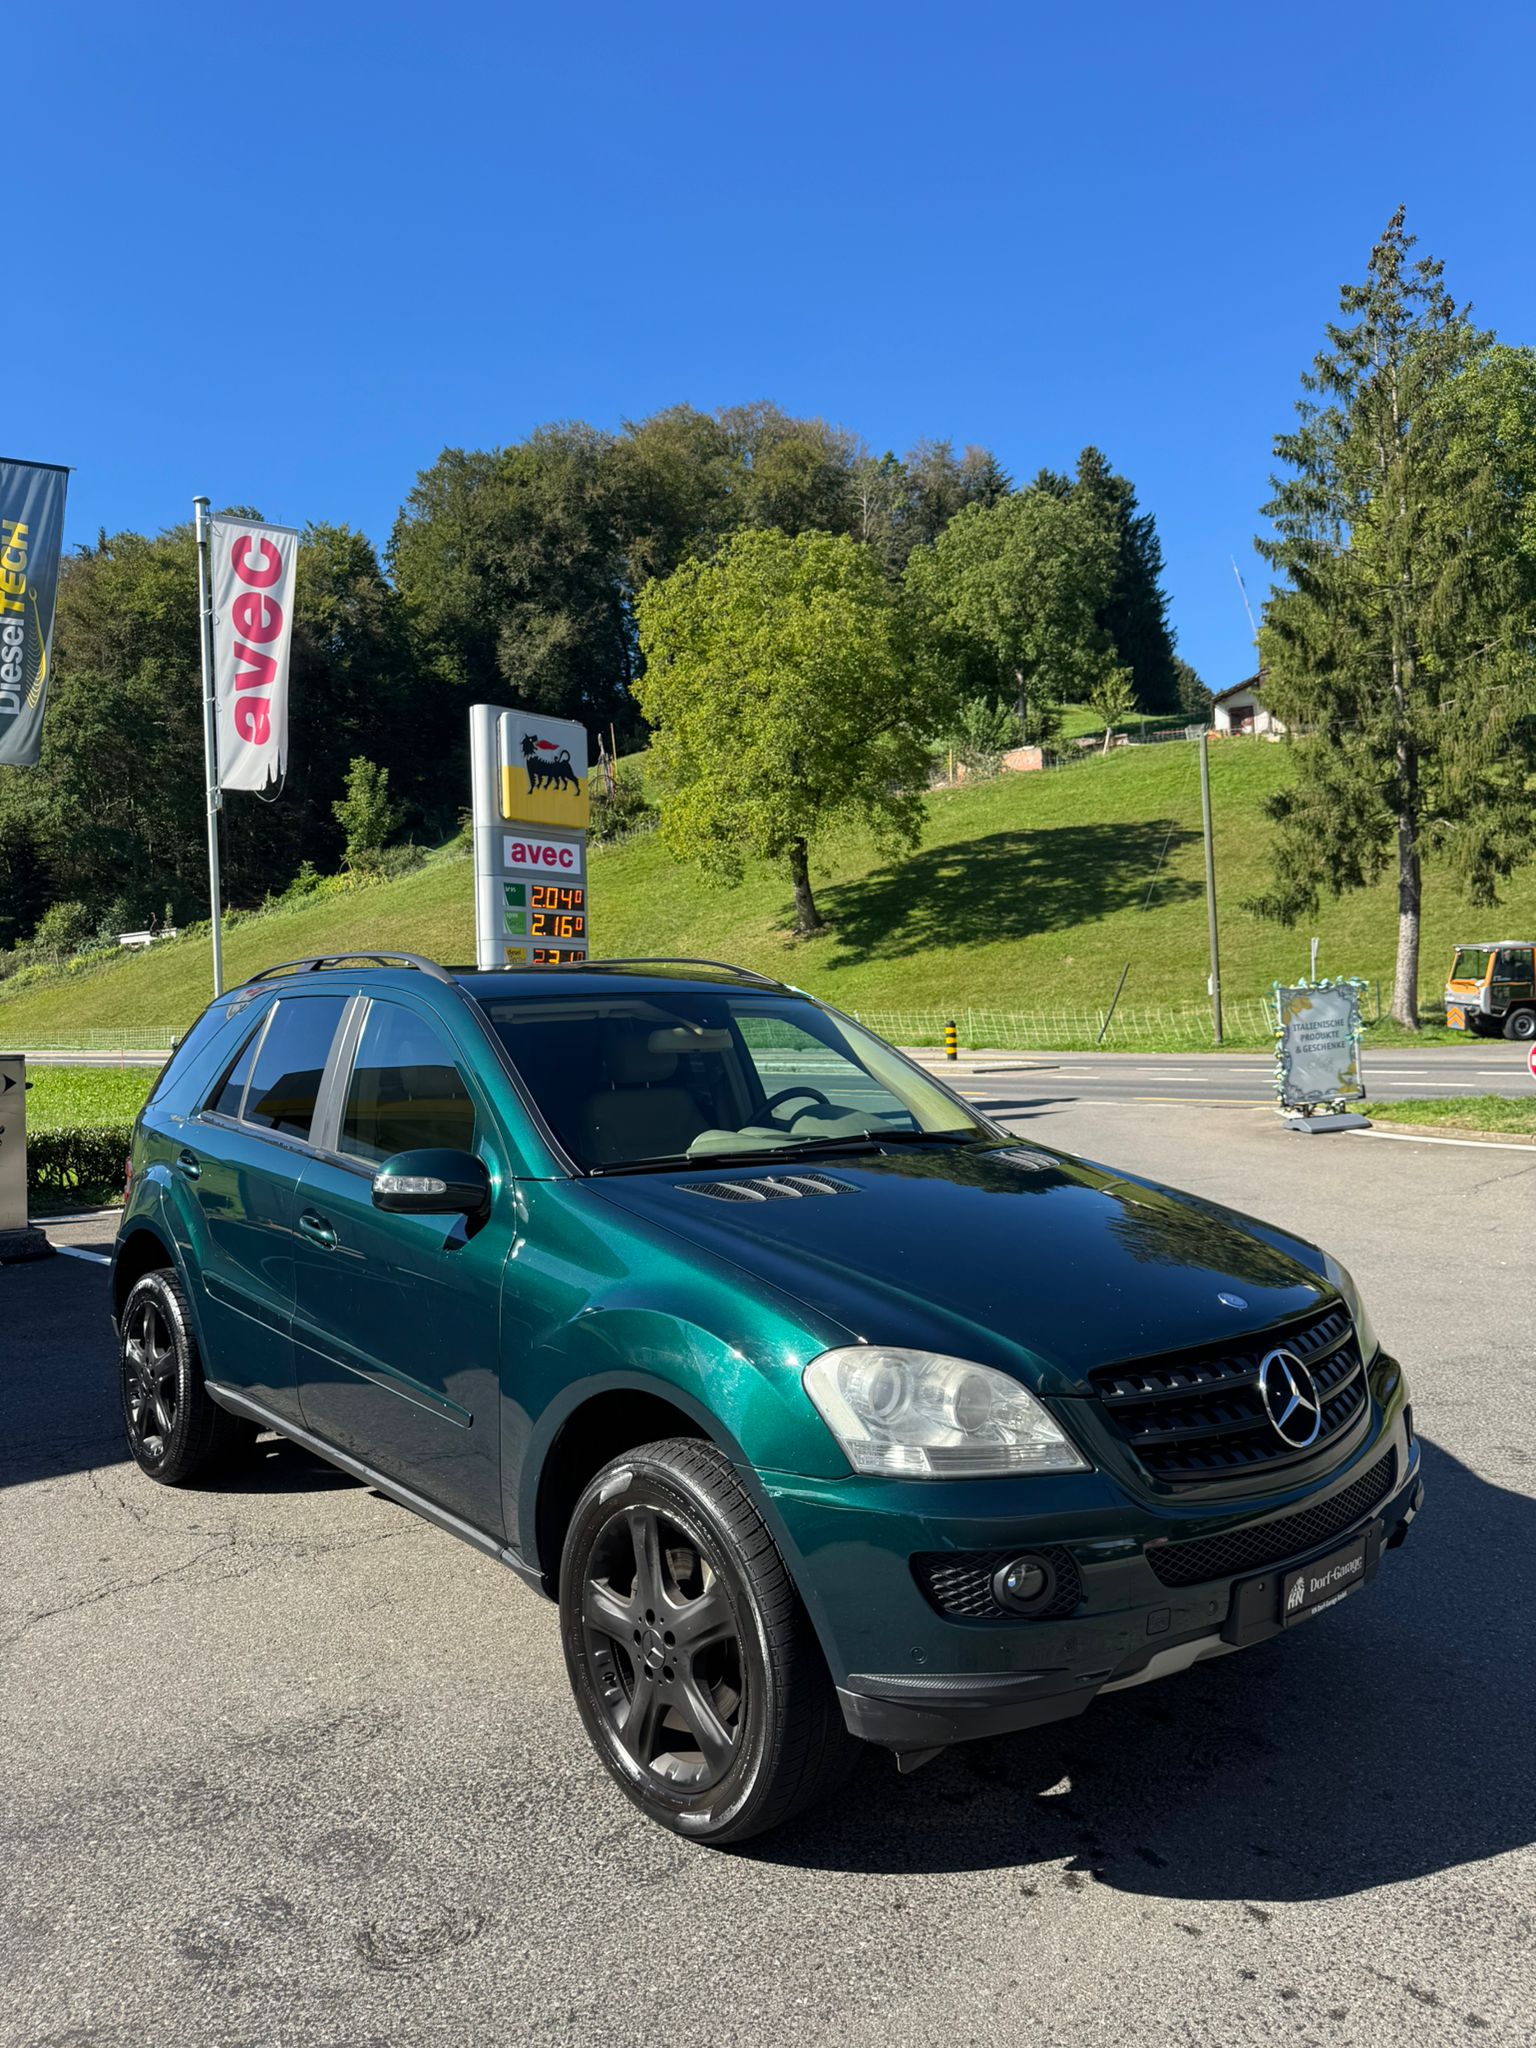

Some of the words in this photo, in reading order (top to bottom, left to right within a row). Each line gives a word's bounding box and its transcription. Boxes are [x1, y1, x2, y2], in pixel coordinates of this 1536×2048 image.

[231, 535, 284, 746] avec
[511, 841, 574, 869] avec
[1292, 1018, 1345, 1032] ITALIENISCHE
[1300, 1030, 1340, 1042] PRODUKTE
[1295, 1045, 1302, 1054] &
[1302, 1040, 1346, 1053] GESCHENKE
[1310, 1556, 1363, 1592] Dorf-Garage
